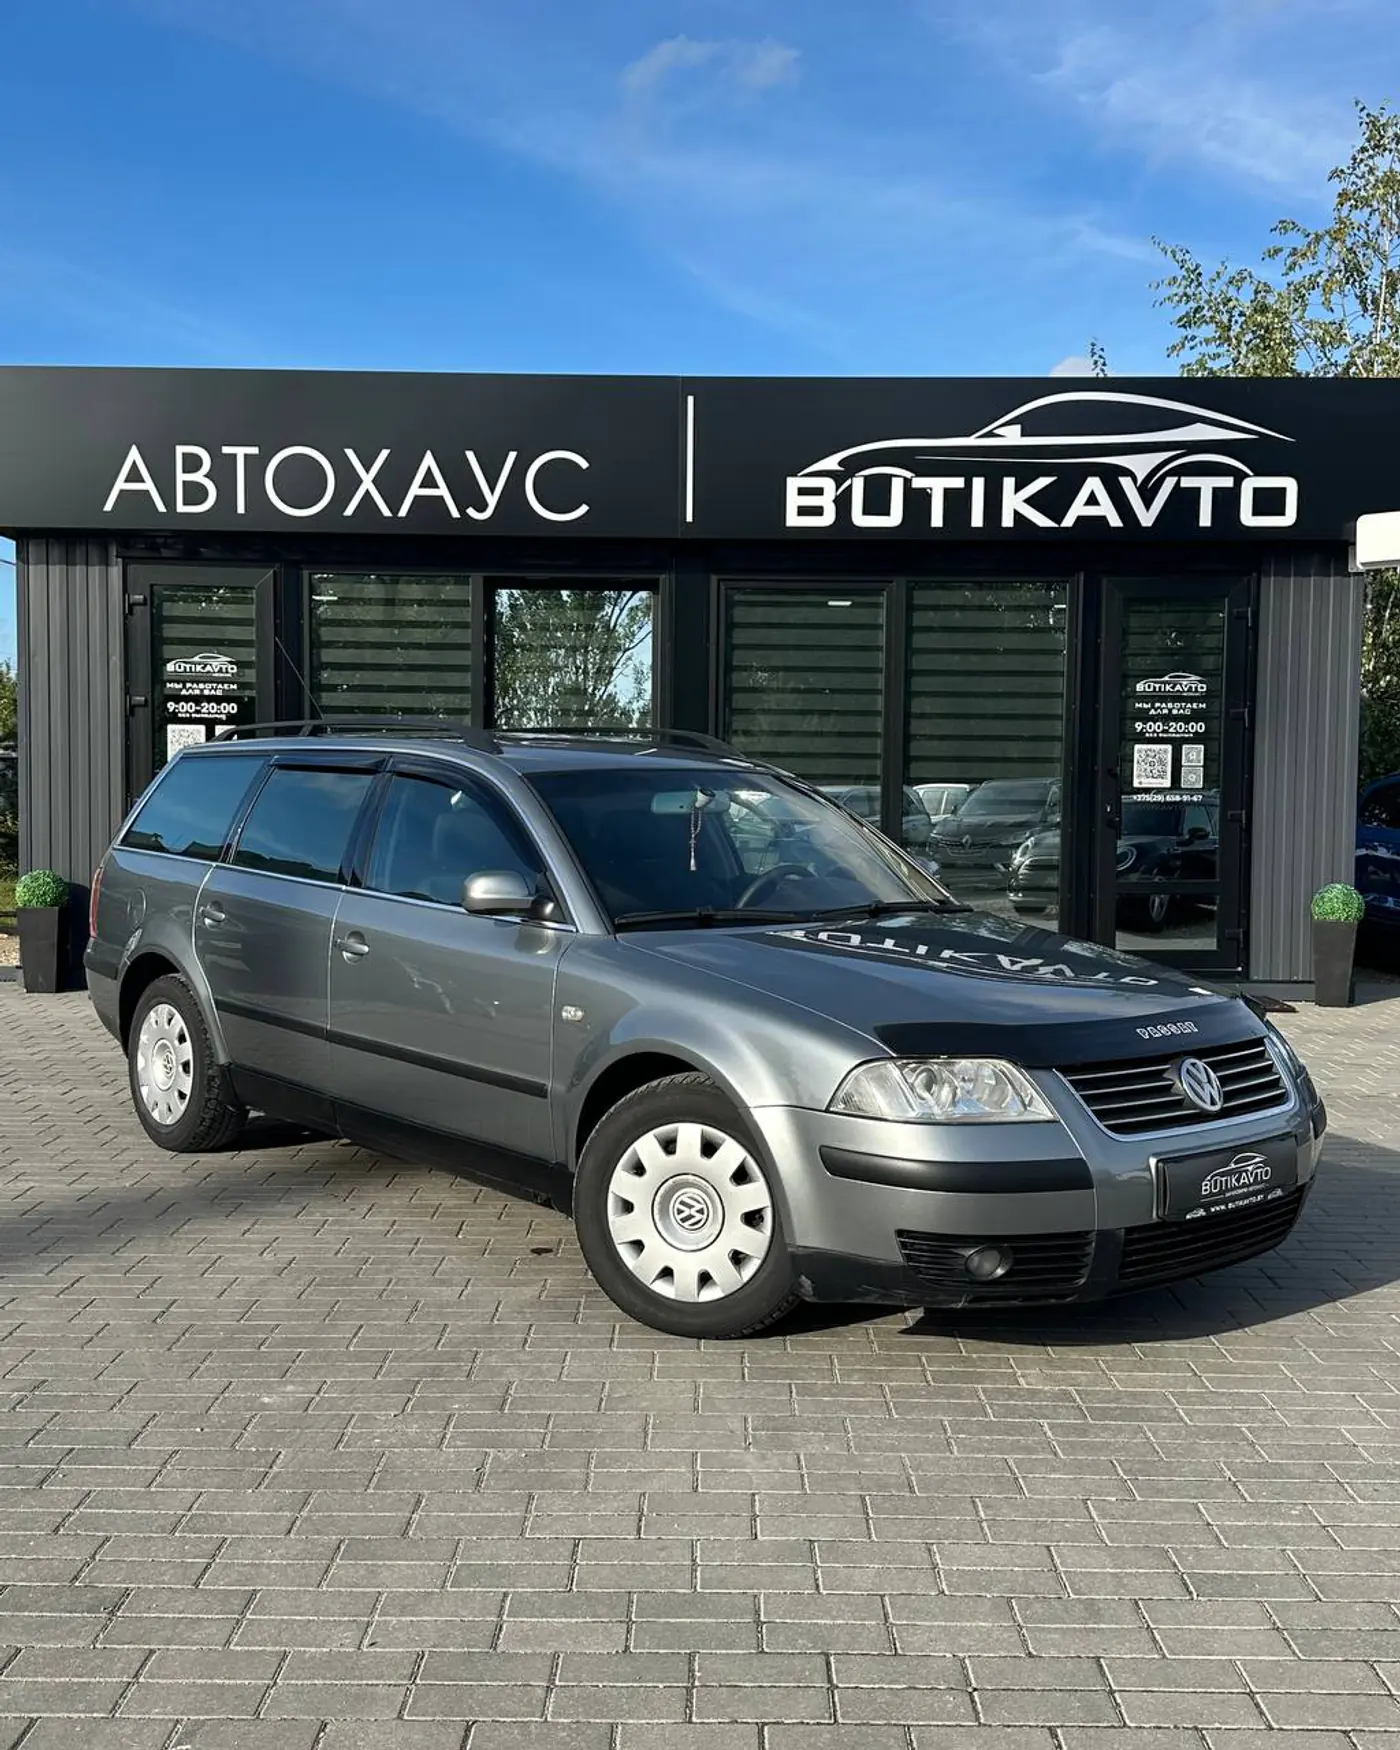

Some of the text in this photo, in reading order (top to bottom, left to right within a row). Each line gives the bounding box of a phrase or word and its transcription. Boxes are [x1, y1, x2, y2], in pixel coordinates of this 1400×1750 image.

[103, 443, 591, 522] АВТОХАУС
[785, 475, 1298, 528] BUTIKAVTO
[186, 682, 238, 690] РАБОТАЕМ
[1136, 682, 1207, 692] BUTIKAVTO
[166, 701, 238, 714] 9:00-20:00
[1154, 702, 1206, 710] РАБОТАЕМ
[1134, 721, 1206, 733] 9:00-20:00
[1201, 1166, 1272, 1195] BUTIKAVTO
